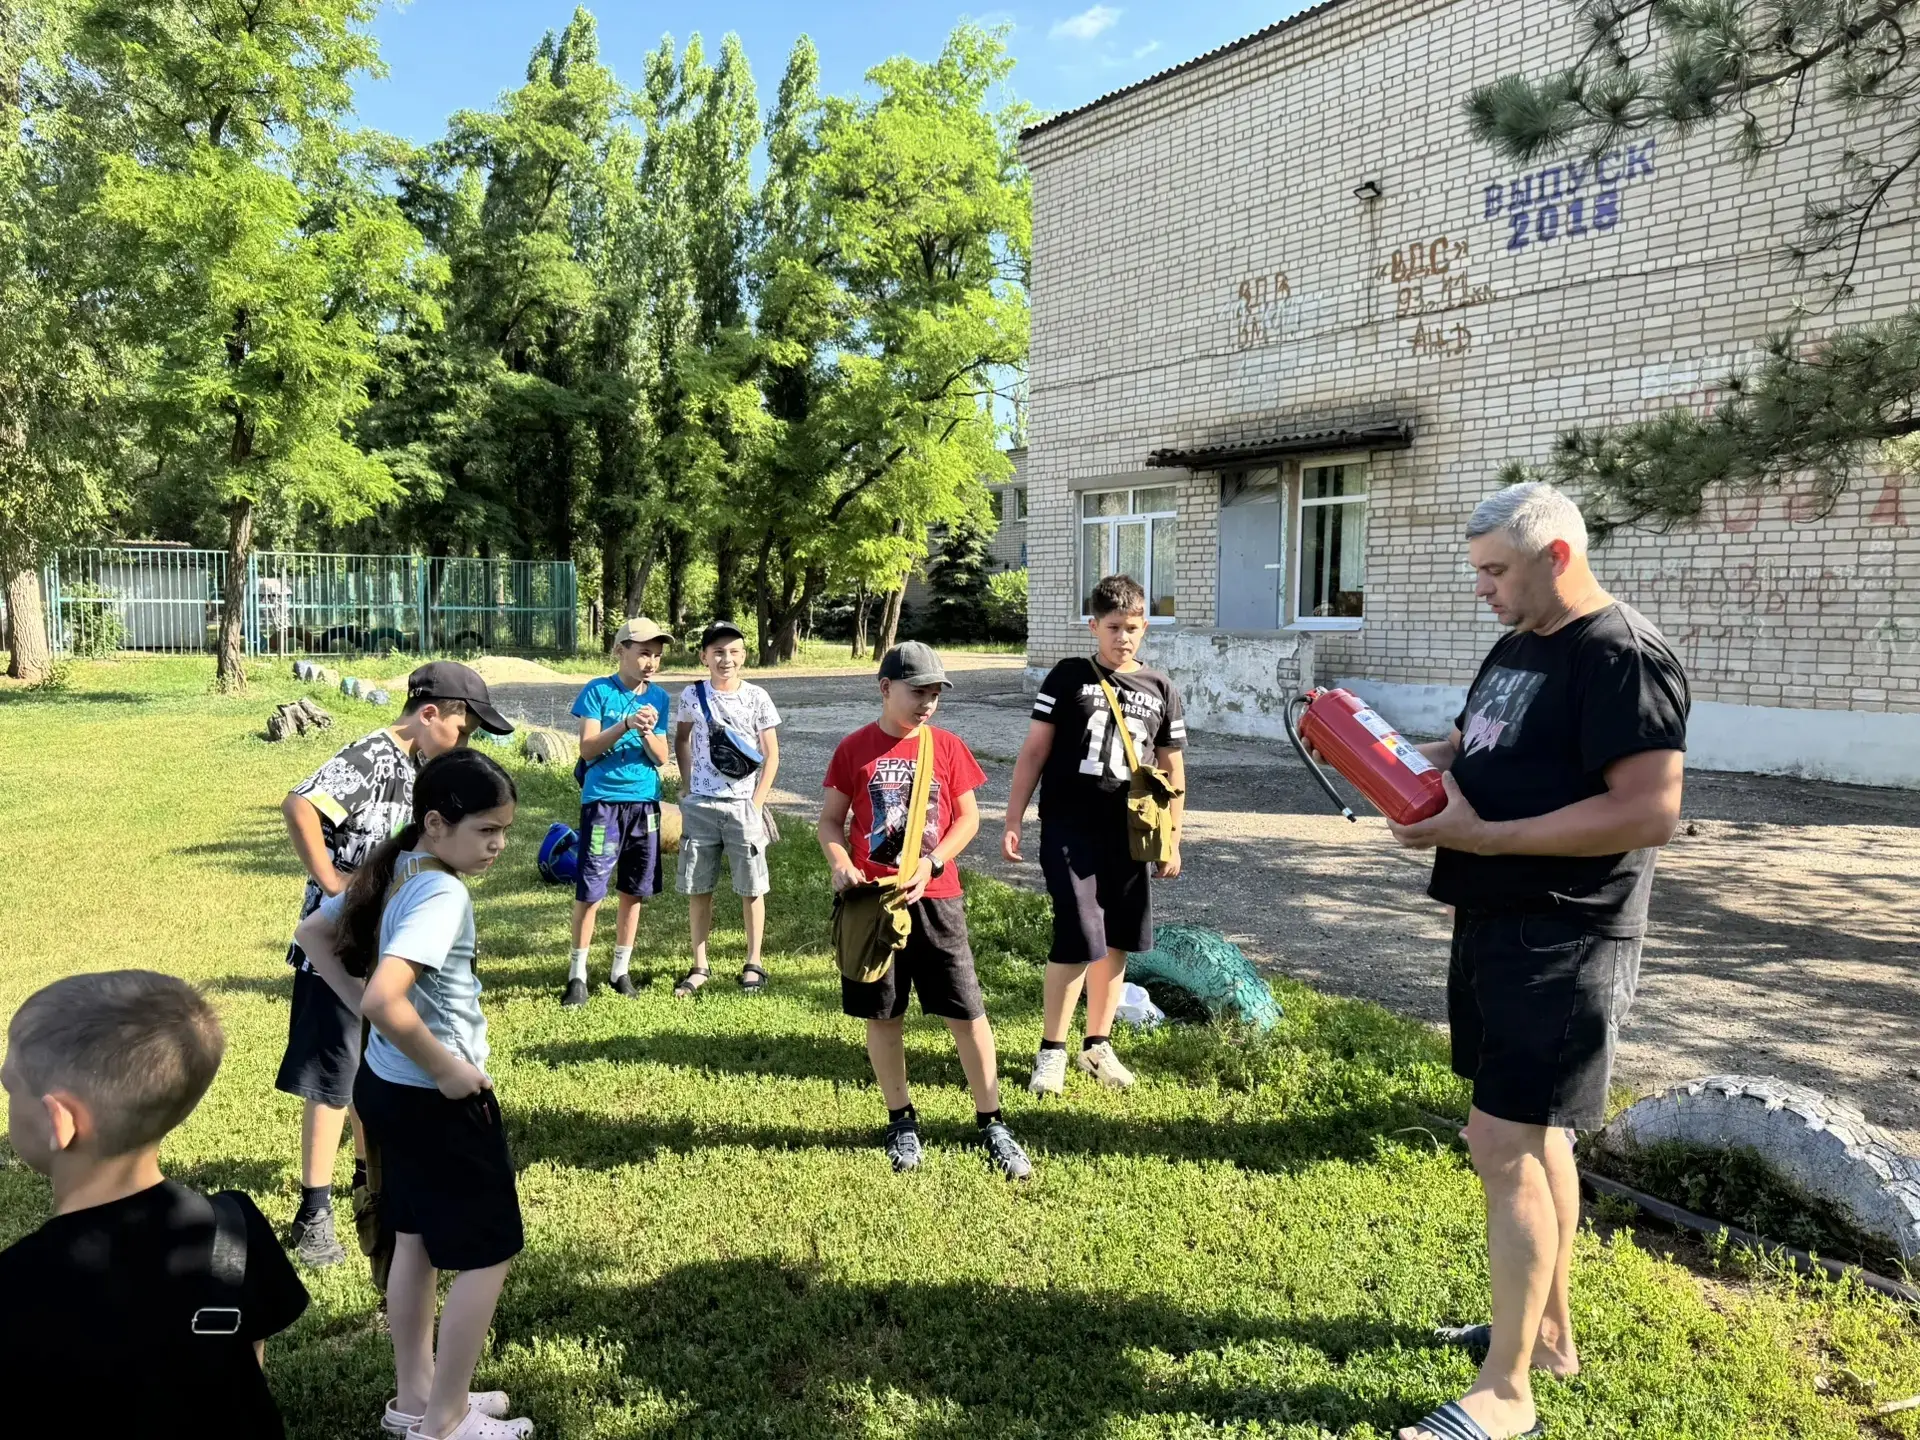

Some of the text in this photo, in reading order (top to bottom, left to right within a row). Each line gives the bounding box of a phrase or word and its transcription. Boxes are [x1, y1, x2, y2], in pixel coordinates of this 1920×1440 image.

[1484, 138, 1656, 218] ВЫПУСК
[1507, 191, 1618, 250] 2018
[1093, 698, 1106, 708] BE
[1124, 690, 1163, 712] YORK
[876, 759, 918, 770] SPAC
